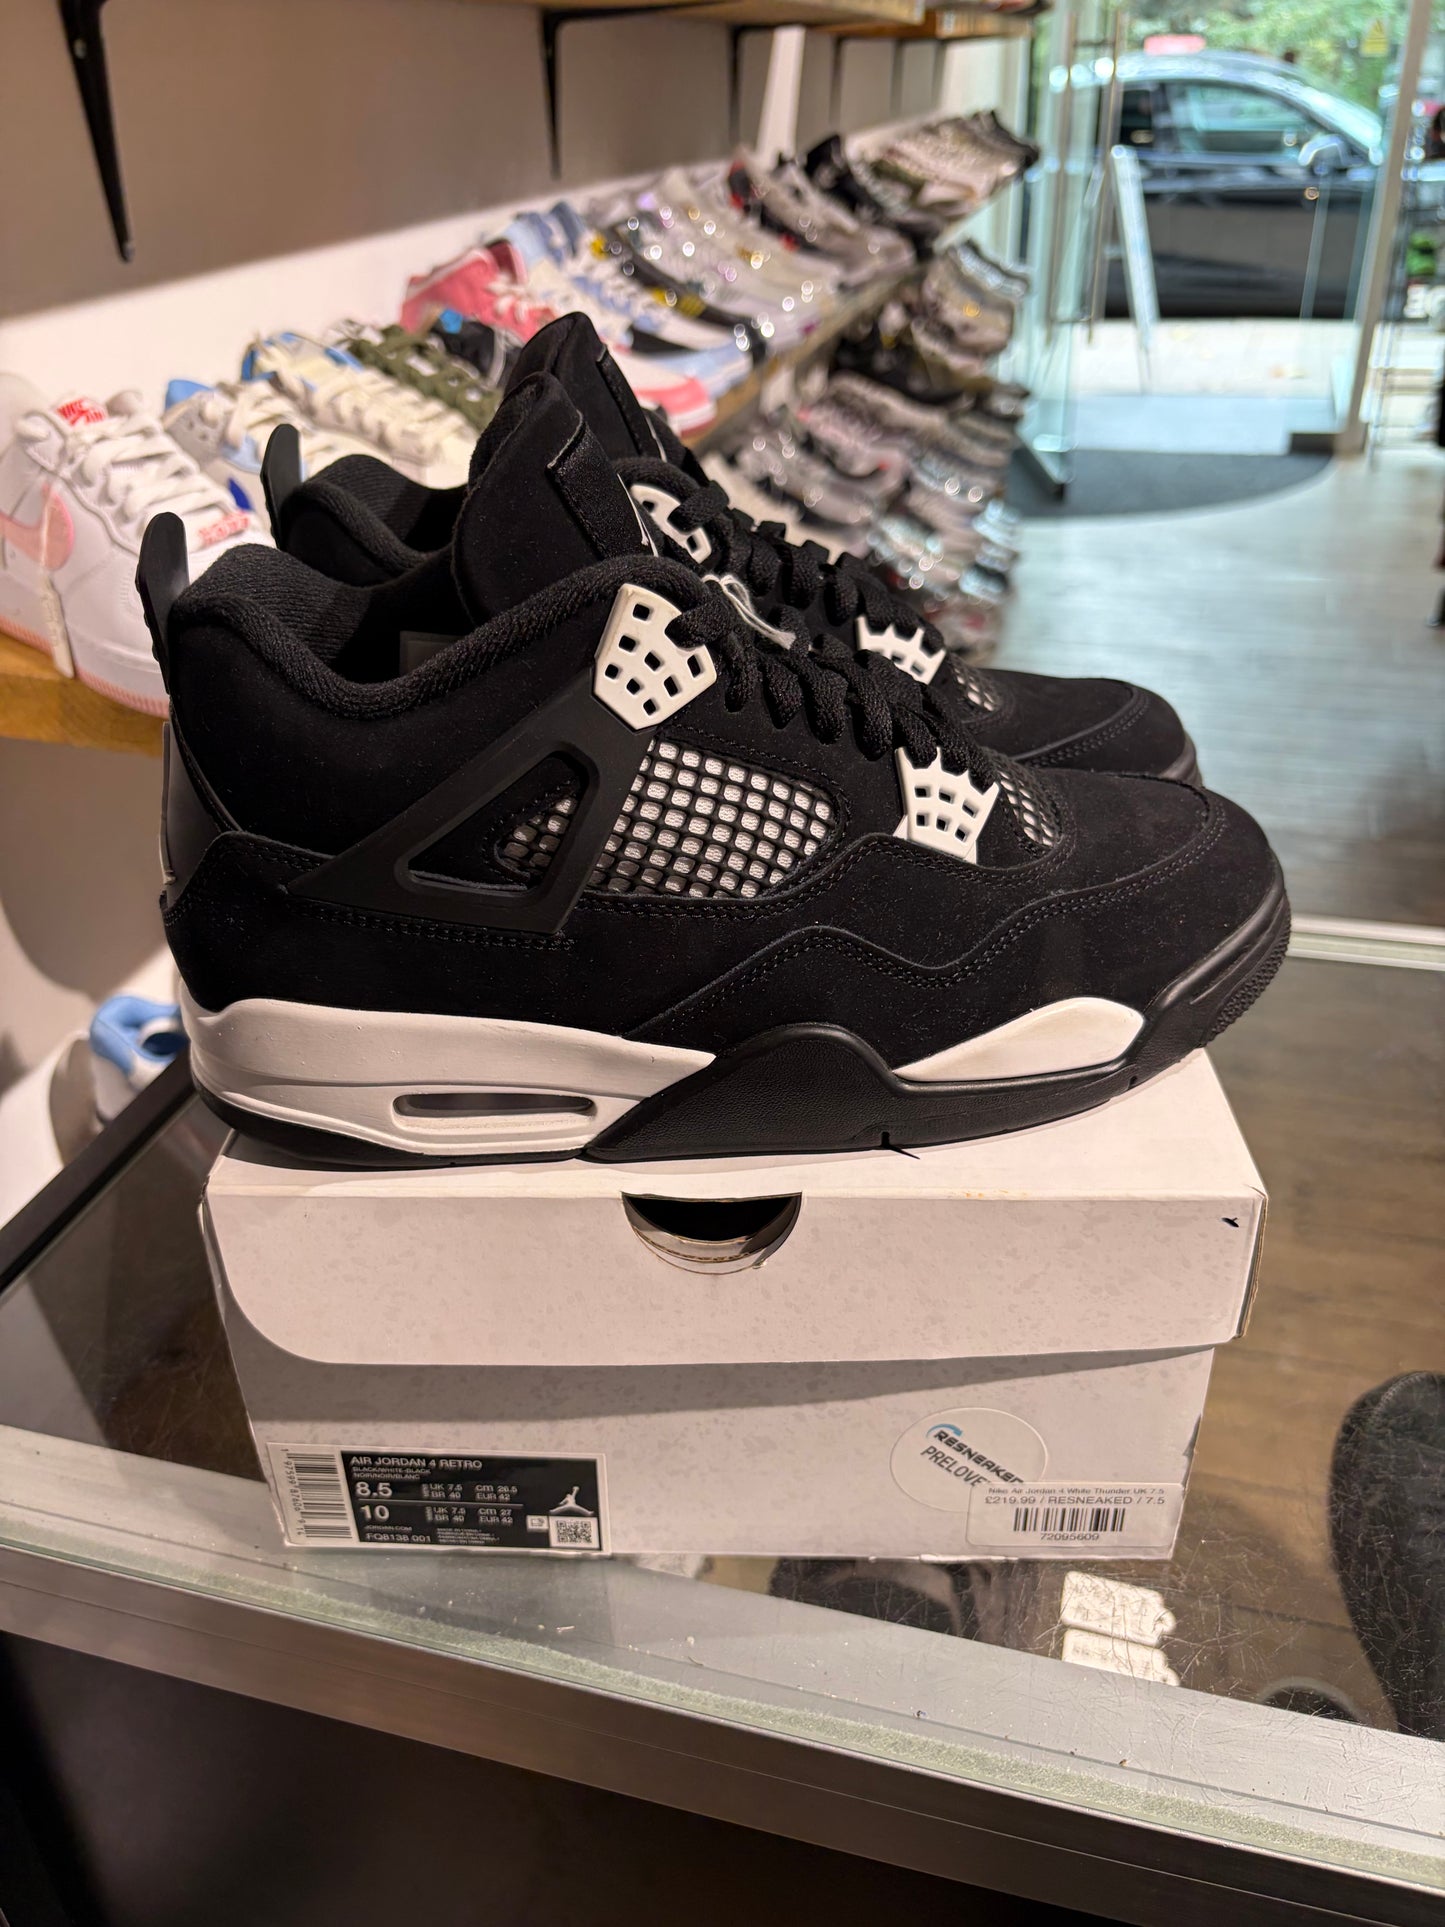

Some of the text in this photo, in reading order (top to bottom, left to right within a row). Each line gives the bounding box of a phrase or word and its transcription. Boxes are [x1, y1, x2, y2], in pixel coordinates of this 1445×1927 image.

[350, 1455, 483, 1469] AIR JORDAN 4 RETRO
[920, 1445, 992, 1487] PRELOVE
[355, 1481, 393, 1497] 8.5
[430, 1483, 444, 1491] UK
[447, 1484, 463, 1492] 7.5
[497, 1485, 518, 1494] 26.5
[1025, 1487, 1056, 1495] Jordan
[1067, 1487, 1091, 1495] White
[1094, 1487, 1130, 1495] Thunder
[431, 1491, 462, 1500] BR 40
[475, 1493, 511, 1502] EUR 42
[985, 1496, 1036, 1505] £219.99
[1048, 1496, 1133, 1505] RESNEAKED
[1146, 1496, 1165, 1505] 7.5
[360, 1504, 390, 1522] 10
[433, 1506, 448, 1514] UK
[500, 1508, 513, 1516] 27
[434, 1514, 465, 1523] BR 40
[479, 1516, 514, 1524] EUR 42
[1040, 1532, 1100, 1541] 72095609
